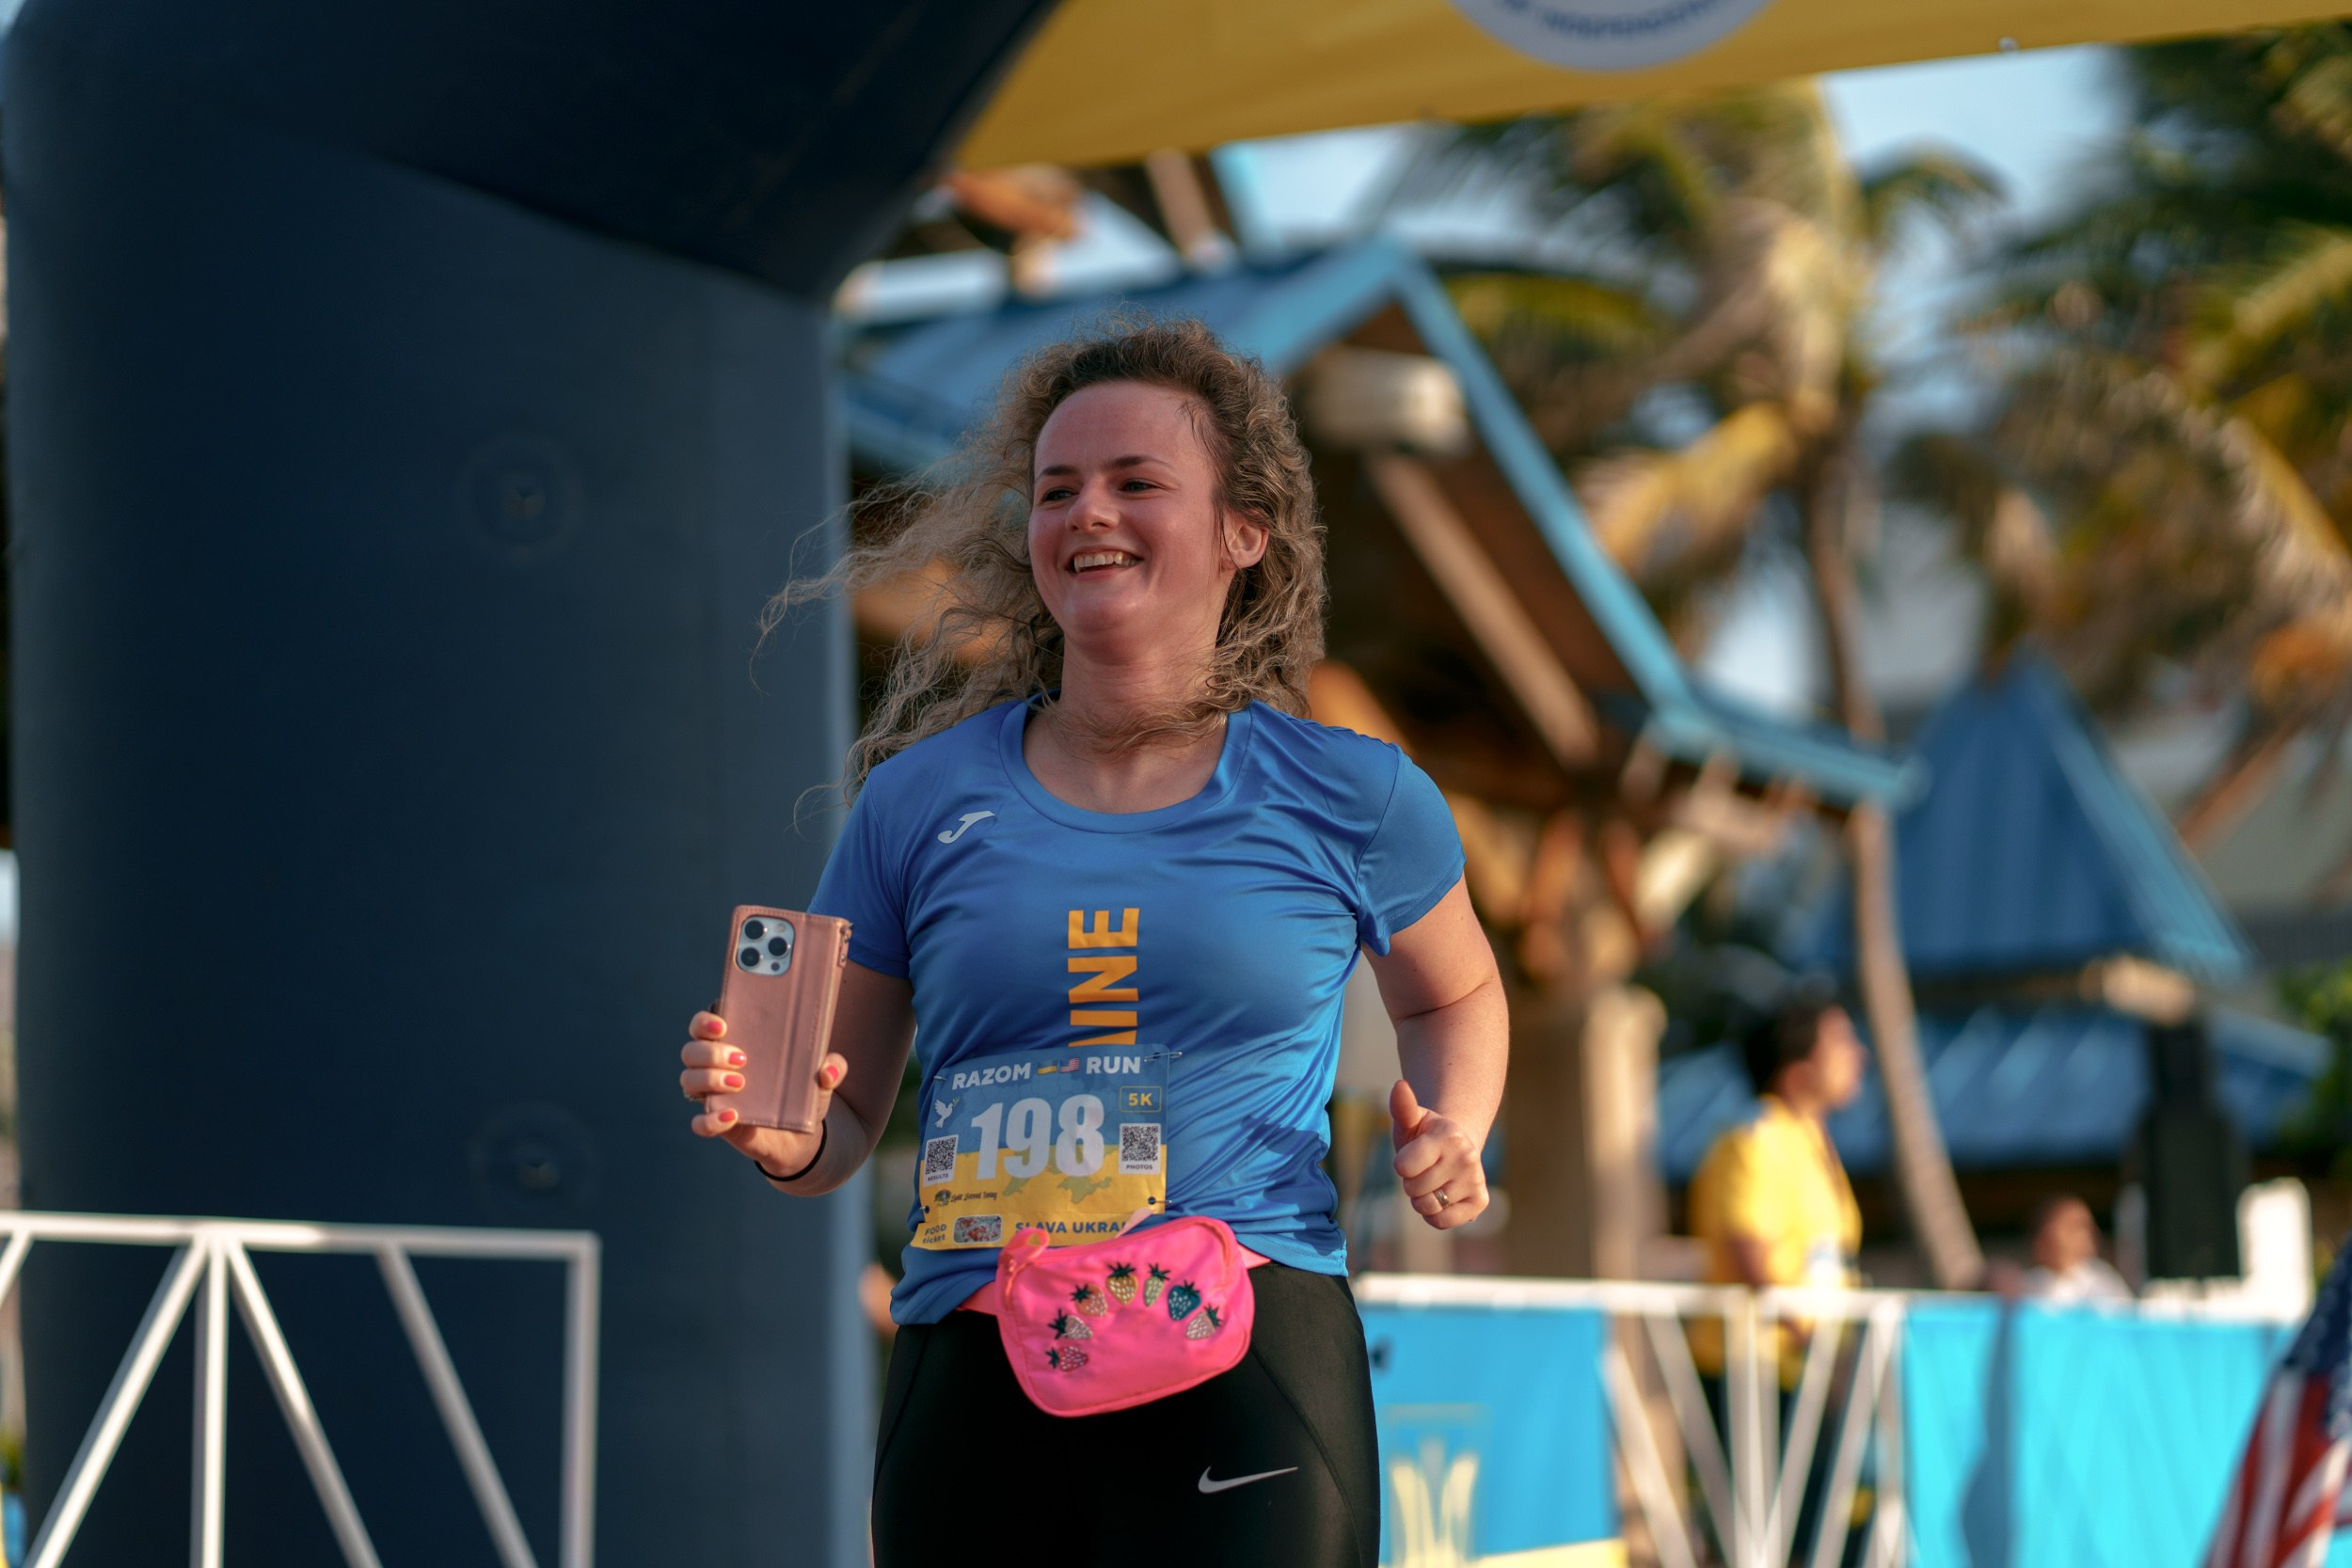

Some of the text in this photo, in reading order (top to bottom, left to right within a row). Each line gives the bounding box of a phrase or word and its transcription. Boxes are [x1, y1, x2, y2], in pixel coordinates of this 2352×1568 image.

[952, 1056, 1140, 1090] RAZOM RUN
[1128, 1092, 1152, 1107] 5K
[971, 1094, 1104, 1180] 198
[928, 1173, 949, 1181] RESULTS
[925, 1224, 946, 1236] FOOD
[923, 1234, 946, 1243] ticket
